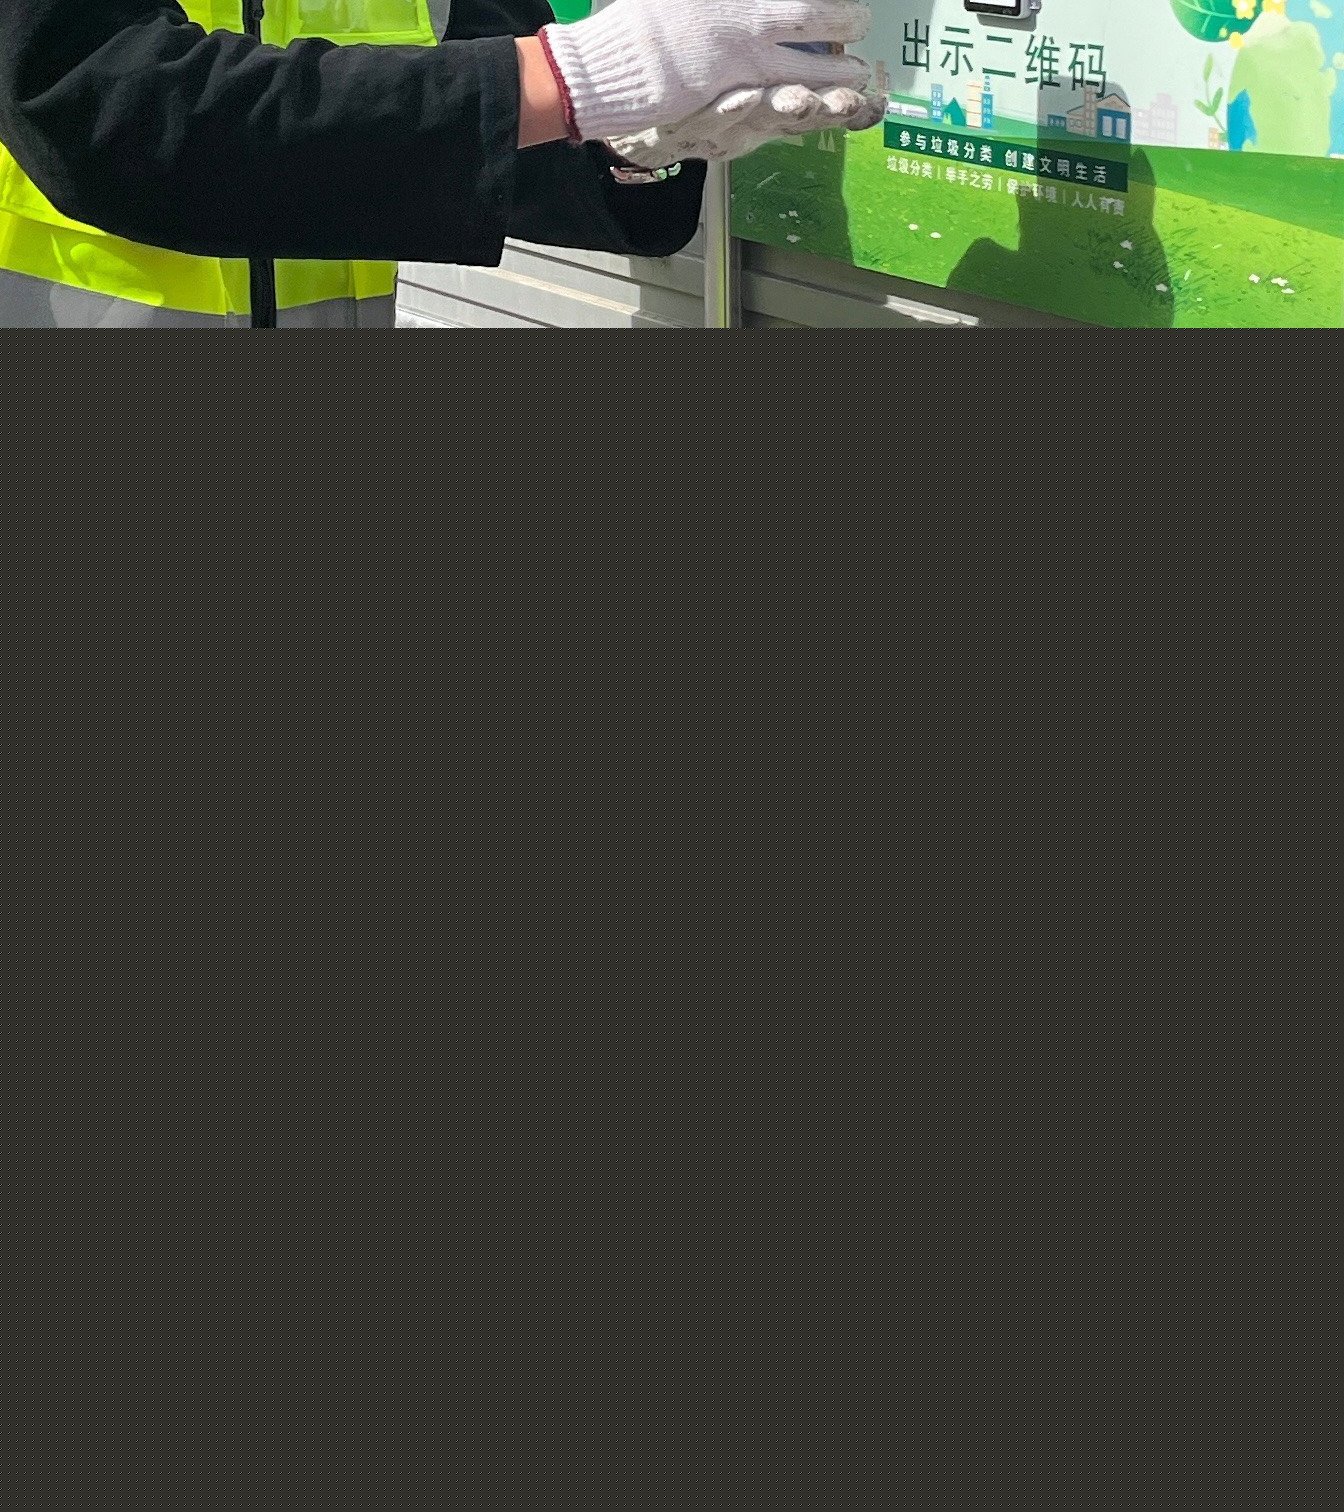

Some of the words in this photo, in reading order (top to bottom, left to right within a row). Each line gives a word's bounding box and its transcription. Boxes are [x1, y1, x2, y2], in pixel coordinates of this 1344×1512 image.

[901, 19, 1107, 96] 出示二维码
[899, 130, 993, 163] 参与垃圾分类
[1005, 149, 1107, 184] 创建文明生活
